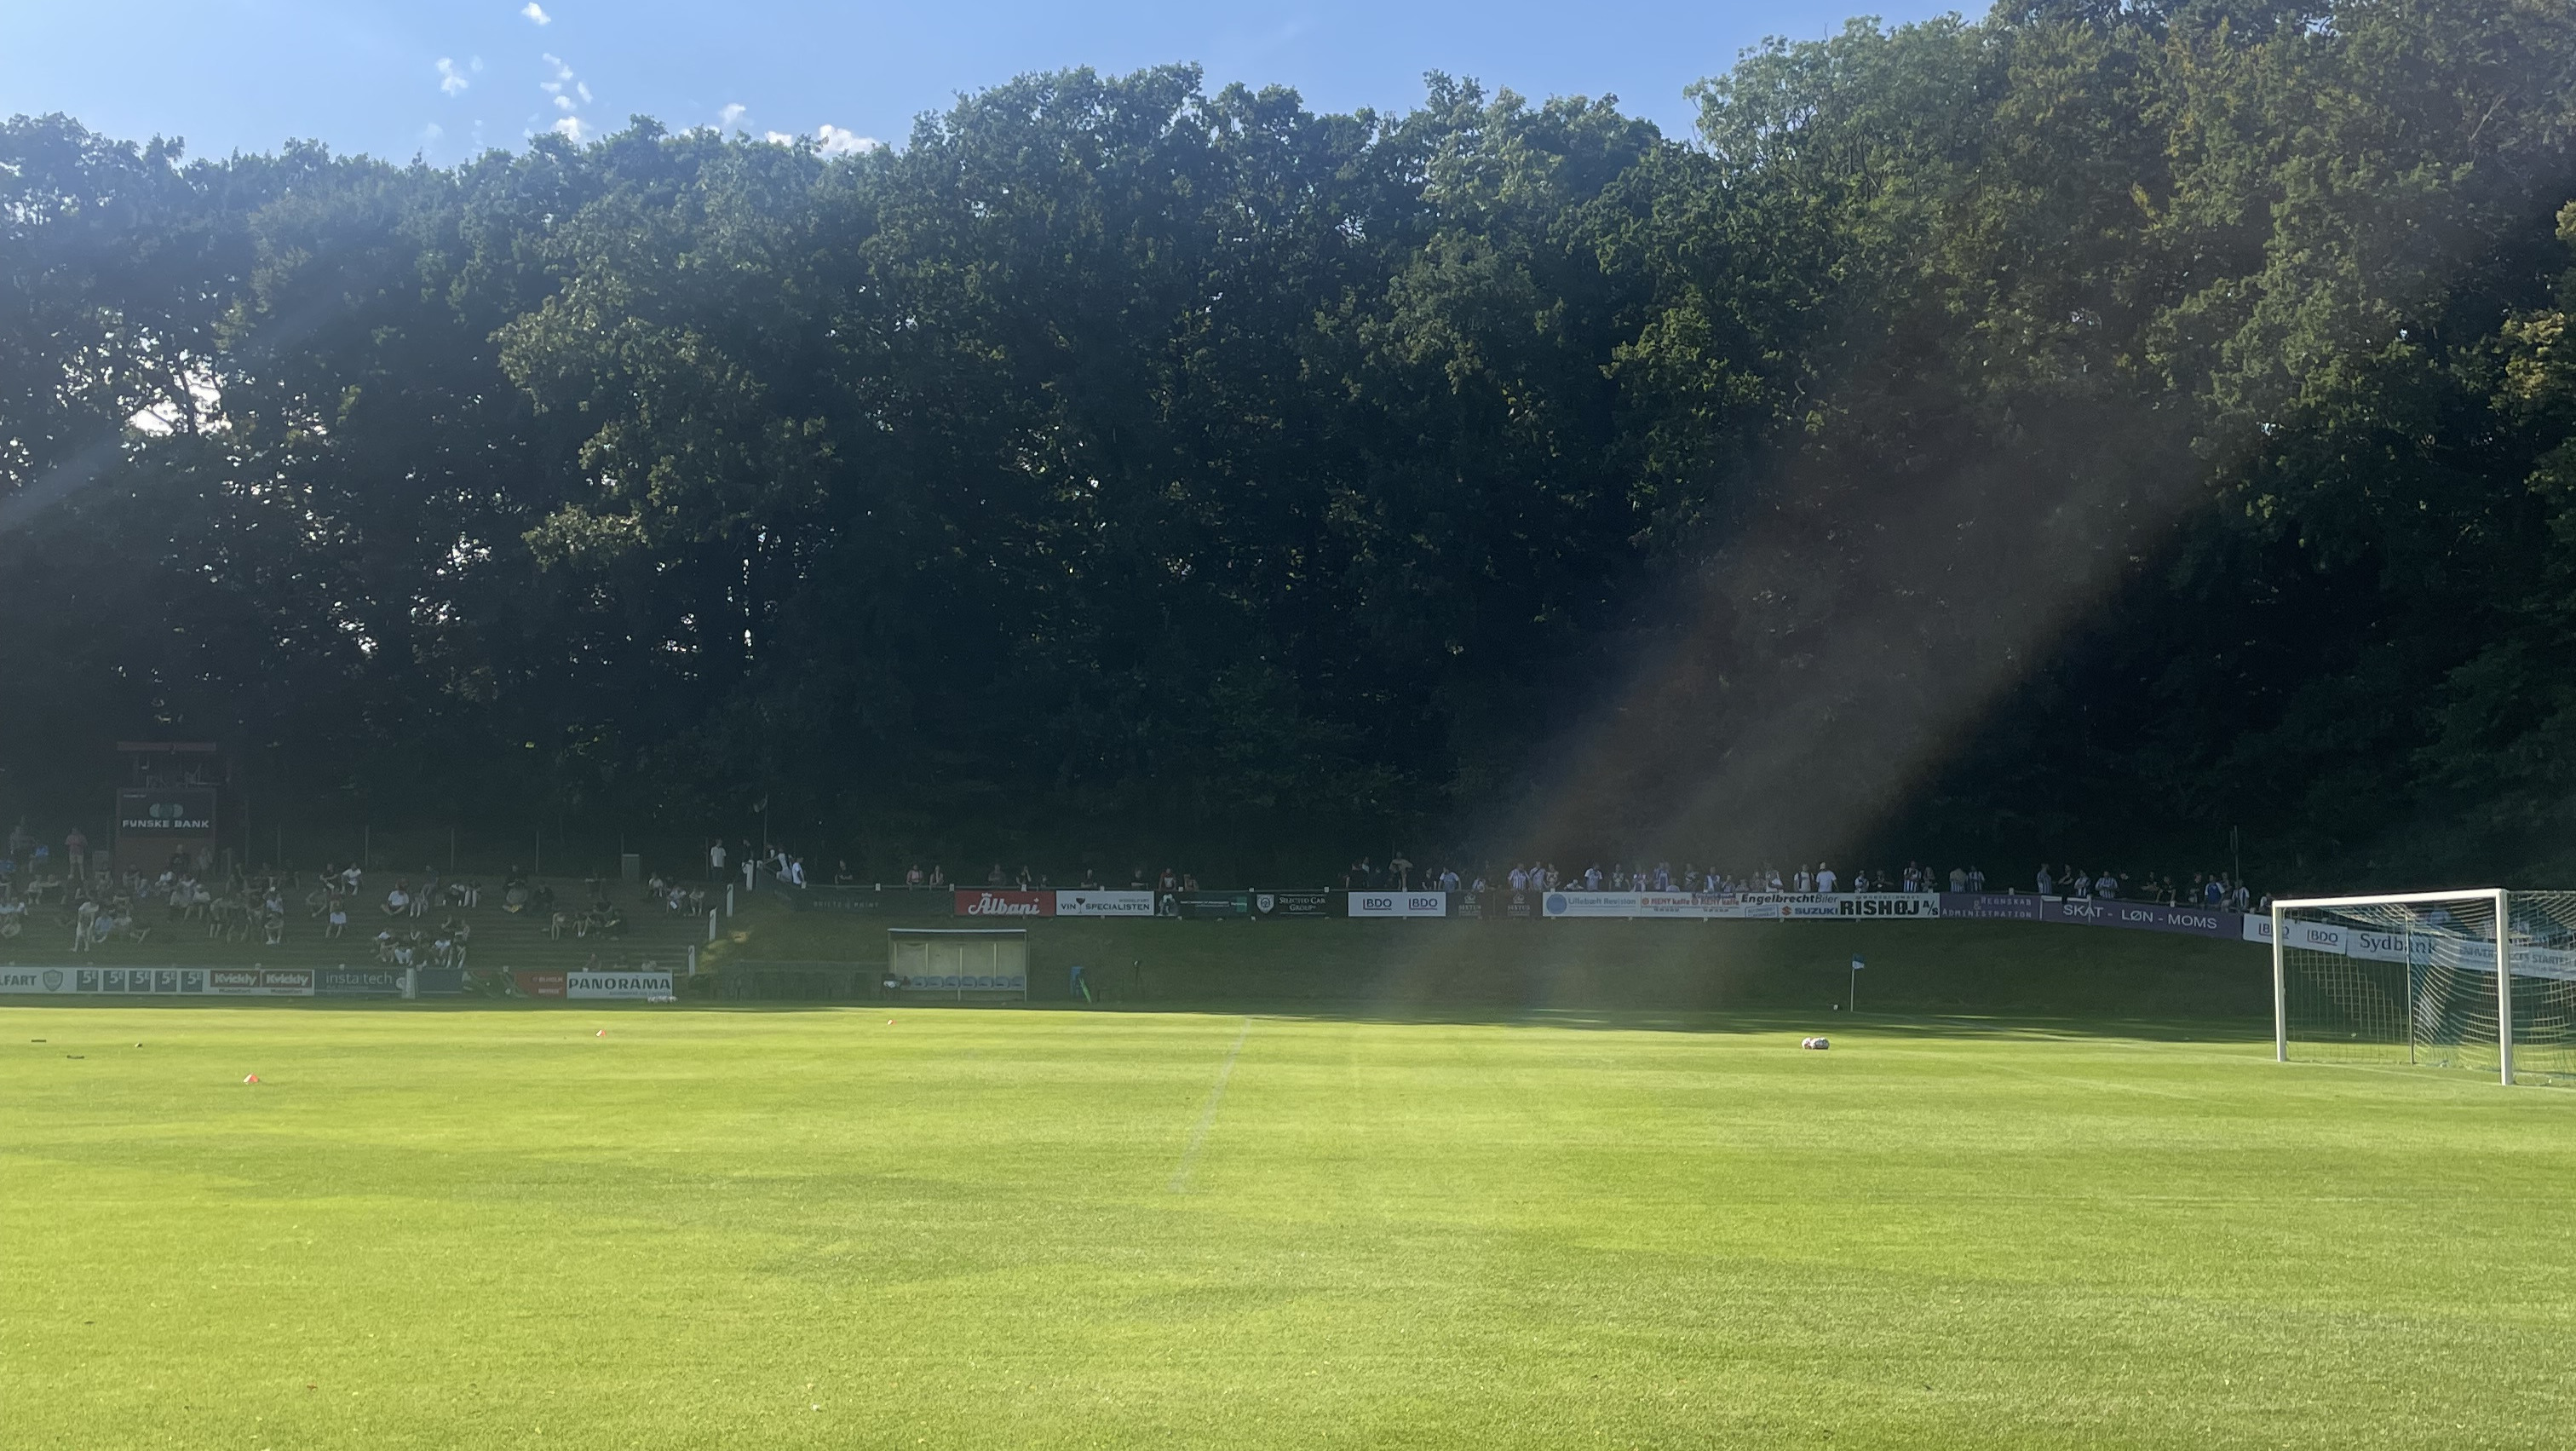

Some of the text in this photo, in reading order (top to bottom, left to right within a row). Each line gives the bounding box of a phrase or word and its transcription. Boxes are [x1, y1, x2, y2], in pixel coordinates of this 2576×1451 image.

[174, 820, 210, 828] BANK
[968, 893, 1040, 915] Albani
[1366, 899, 1392, 907] BDO
[1412, 899, 1438, 907] BDO
[1981, 896, 2031, 906] REGNSKAB
[1840, 900, 1938, 915] RISHØJ A/S
[1942, 908, 2032, 918] ADMINISTRATION
[2063, 904, 2104, 918] SKAT
[2121, 909, 2153, 922] LØN
[2168, 913, 2217, 929] MOMS
[2263, 924, 2289, 936] BO
[2311, 930, 2338, 942] BDO
[214, 973, 257, 986] Kvickly
[266, 973, 309, 987] Kvickly
